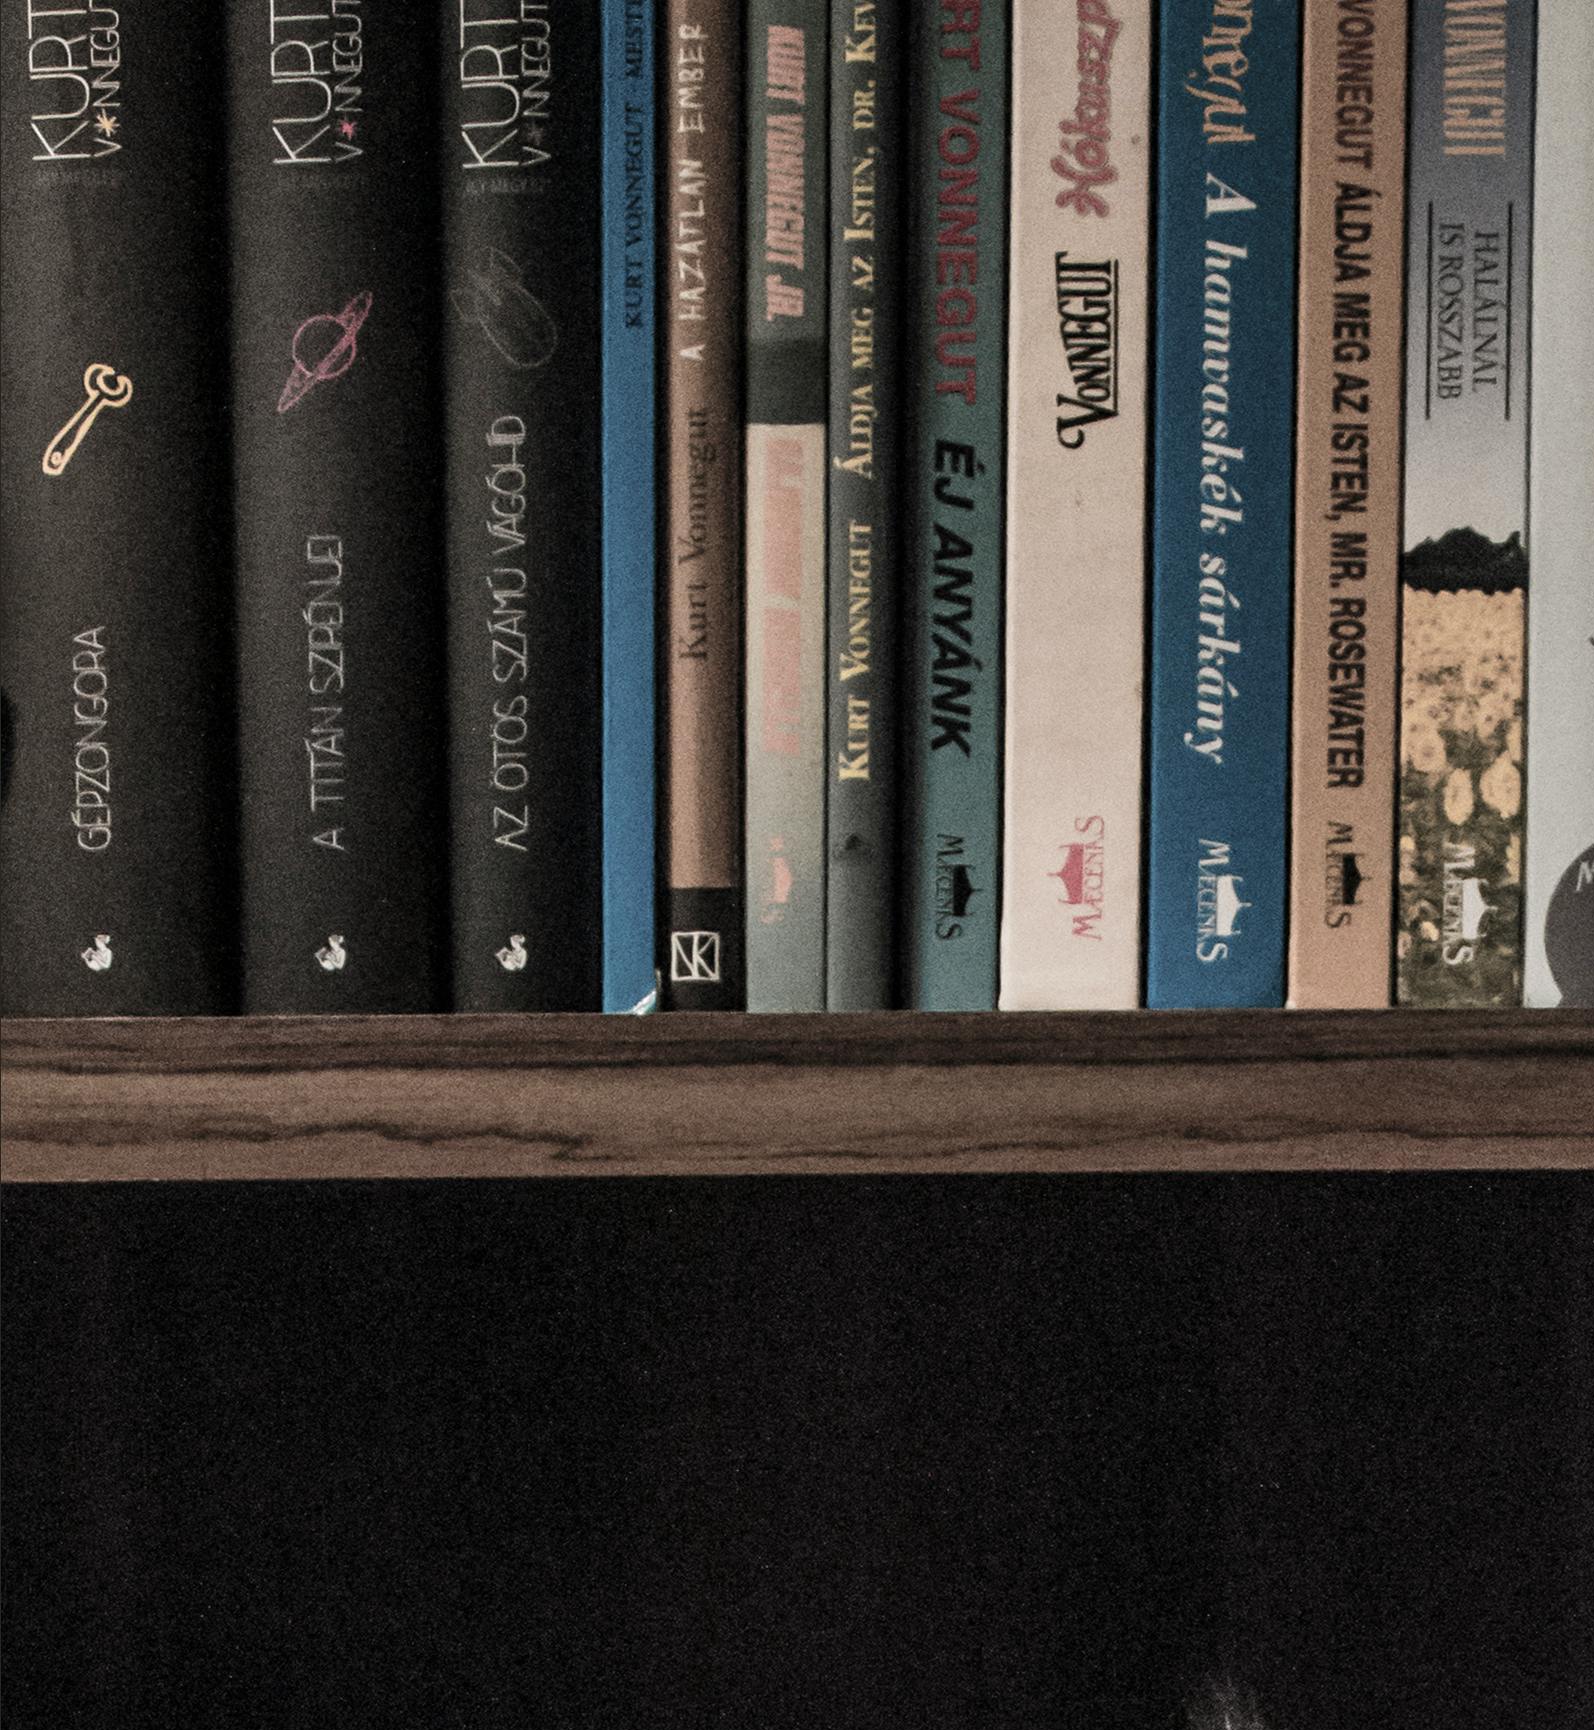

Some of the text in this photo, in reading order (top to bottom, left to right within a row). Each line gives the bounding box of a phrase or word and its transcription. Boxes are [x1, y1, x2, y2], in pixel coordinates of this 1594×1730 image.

[28, 0, 90, 161] KURT
[269, 0, 333, 165] KURT
[460, 0, 523, 170] KURT
[850, 79, 876, 131] DR.
[622, 102, 645, 247] VONNEGUT
[842, 146, 880, 242] ISTEN,
[623, 259, 645, 327] KURT
[673, 22, 716, 661] Kurt Vonnegut A HAZÁTLAN EMBER
[848, 255, 875, 292] AZ
[848, 307, 875, 369] MEG
[1437, 222, 1467, 402] IS ROSSZABB
[1471, 231, 1508, 395] HALÁLNÁL
[833, 384, 879, 479] ÁLDJA
[1326, 0, 1382, 791] VONNEGUT ÁLDJA MEG AZ ISTEN, MR. ROSEWATER
[837, 518, 874, 681] VONNEGUT
[72, 626, 112, 853] GÉPZONGORA
[836, 692, 871, 781] KURT
